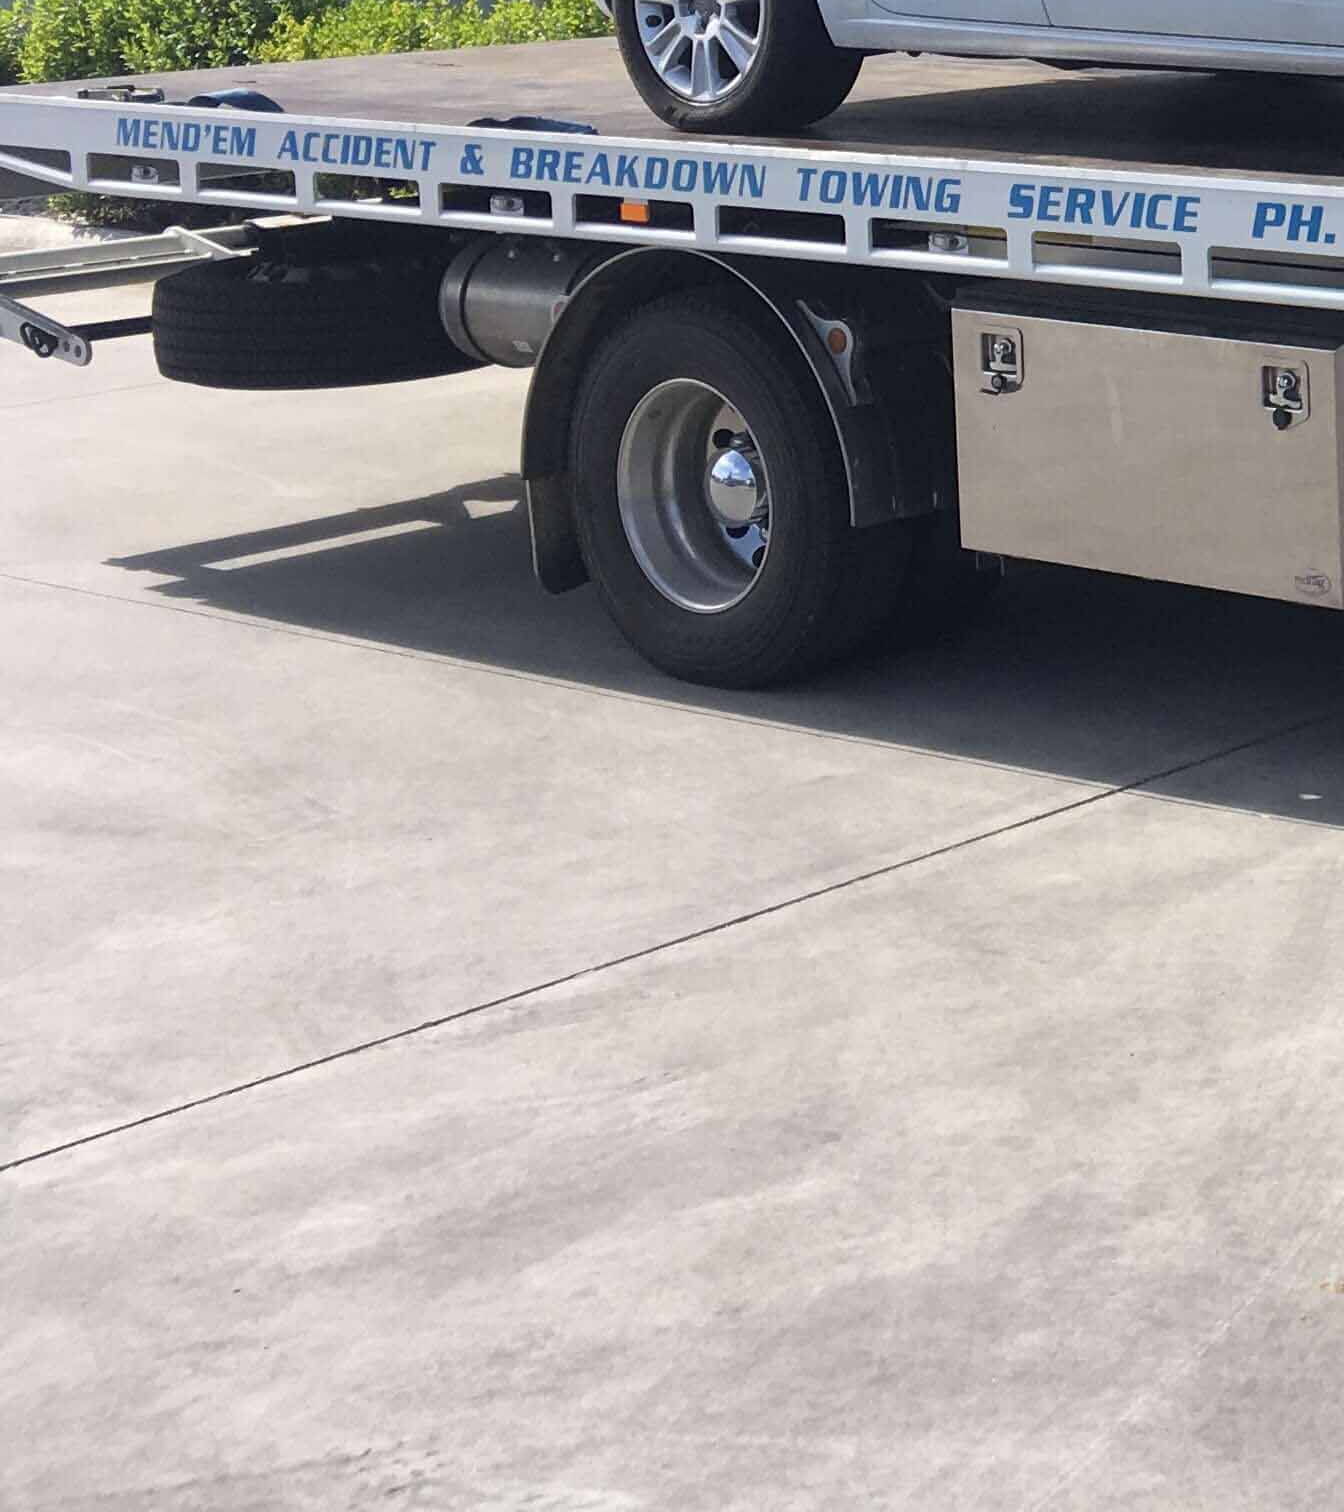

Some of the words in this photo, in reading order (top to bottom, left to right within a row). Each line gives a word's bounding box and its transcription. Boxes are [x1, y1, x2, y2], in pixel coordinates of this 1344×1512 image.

[116, 117, 257, 158] MEND'EM
[277, 130, 436, 172] ACCIDENT
[459, 143, 486, 176] &
[510, 146, 767, 199] BREAKDOWN
[797, 167, 962, 213] TOWING
[1007, 183, 1202, 234] SERVICE
[1252, 201, 1336, 245] PH.
